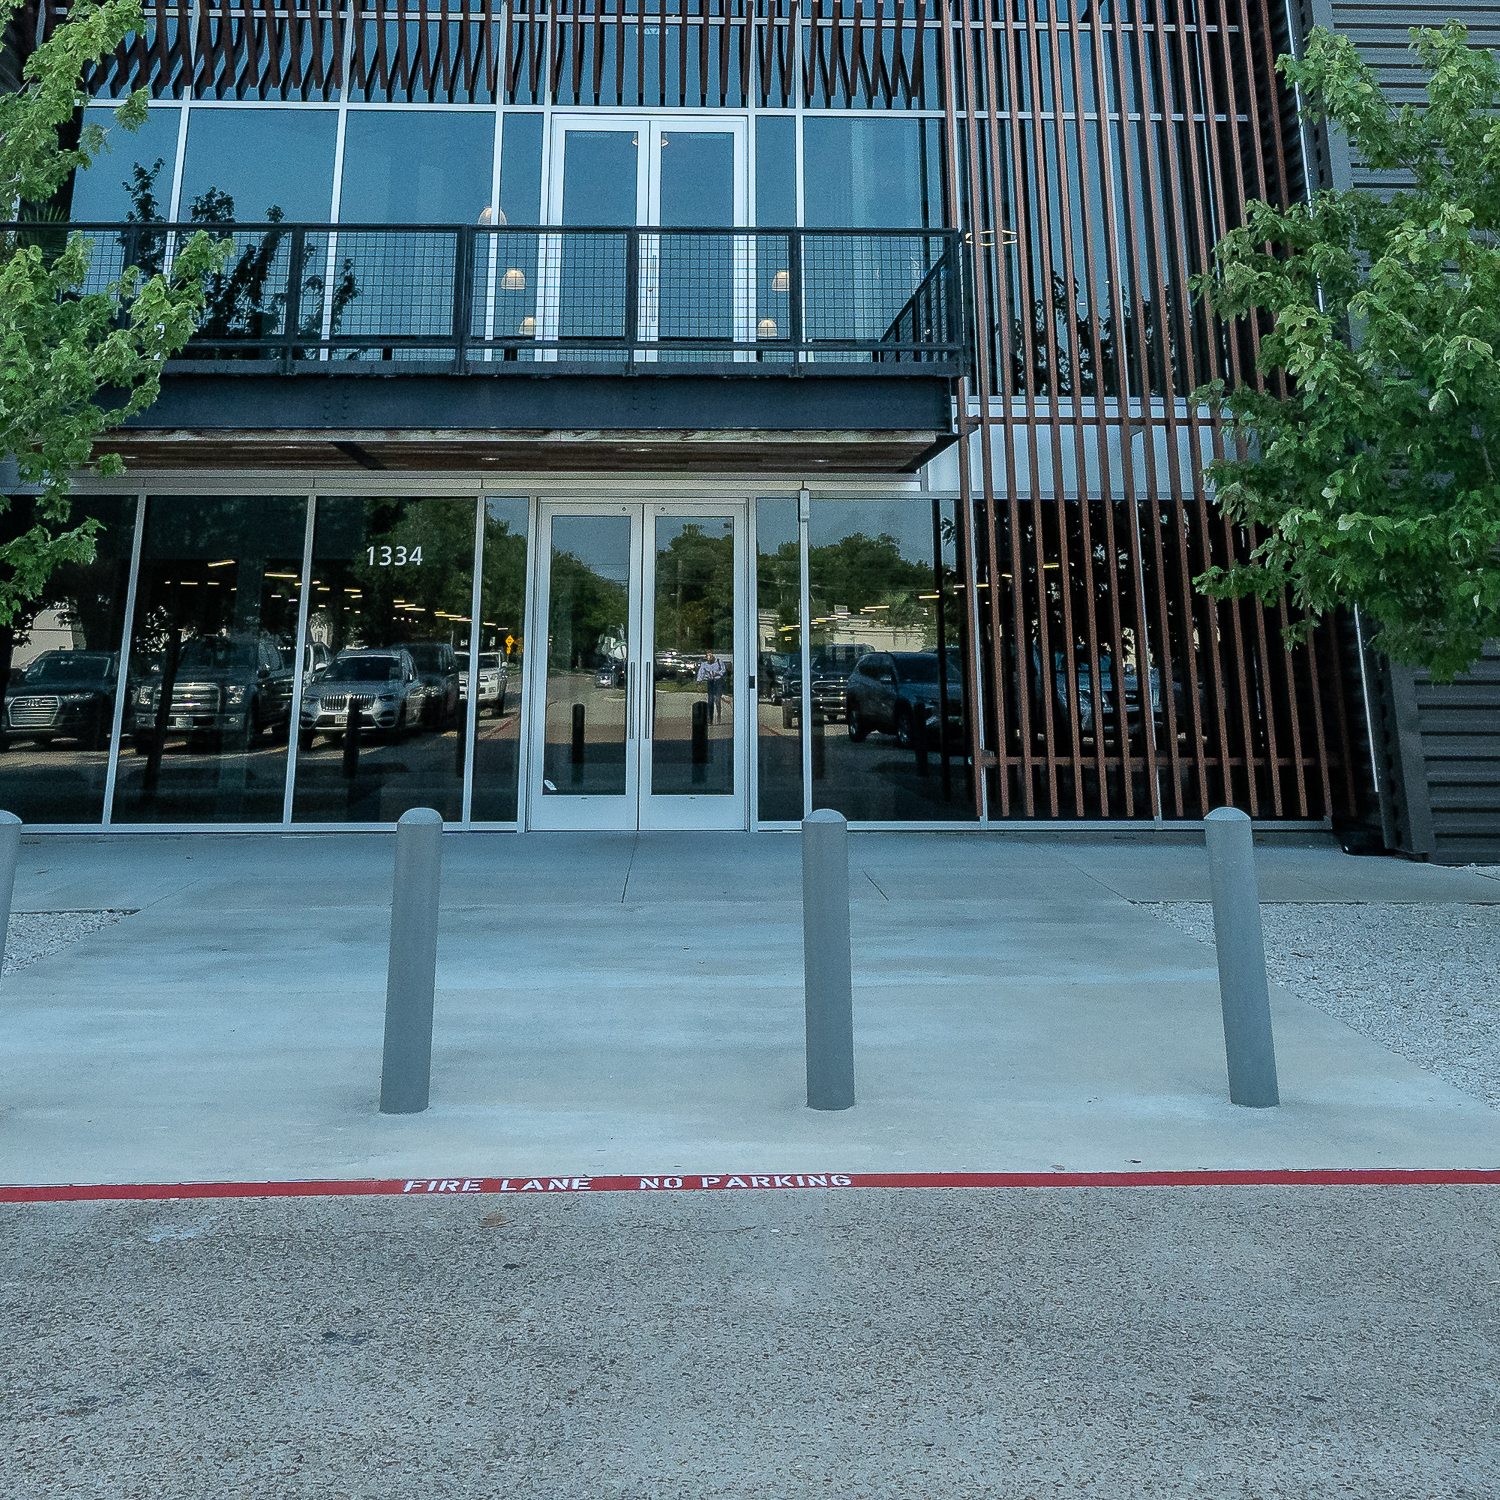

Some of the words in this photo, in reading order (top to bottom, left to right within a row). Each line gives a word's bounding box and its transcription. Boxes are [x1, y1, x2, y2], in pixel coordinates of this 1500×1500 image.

[366, 545, 423, 566] 1334
[403, 1179, 482, 1193] FIRE
[500, 1177, 594, 1192] LANE
[639, 1176, 684, 1190] NO
[701, 1174, 852, 1188] PARKING
